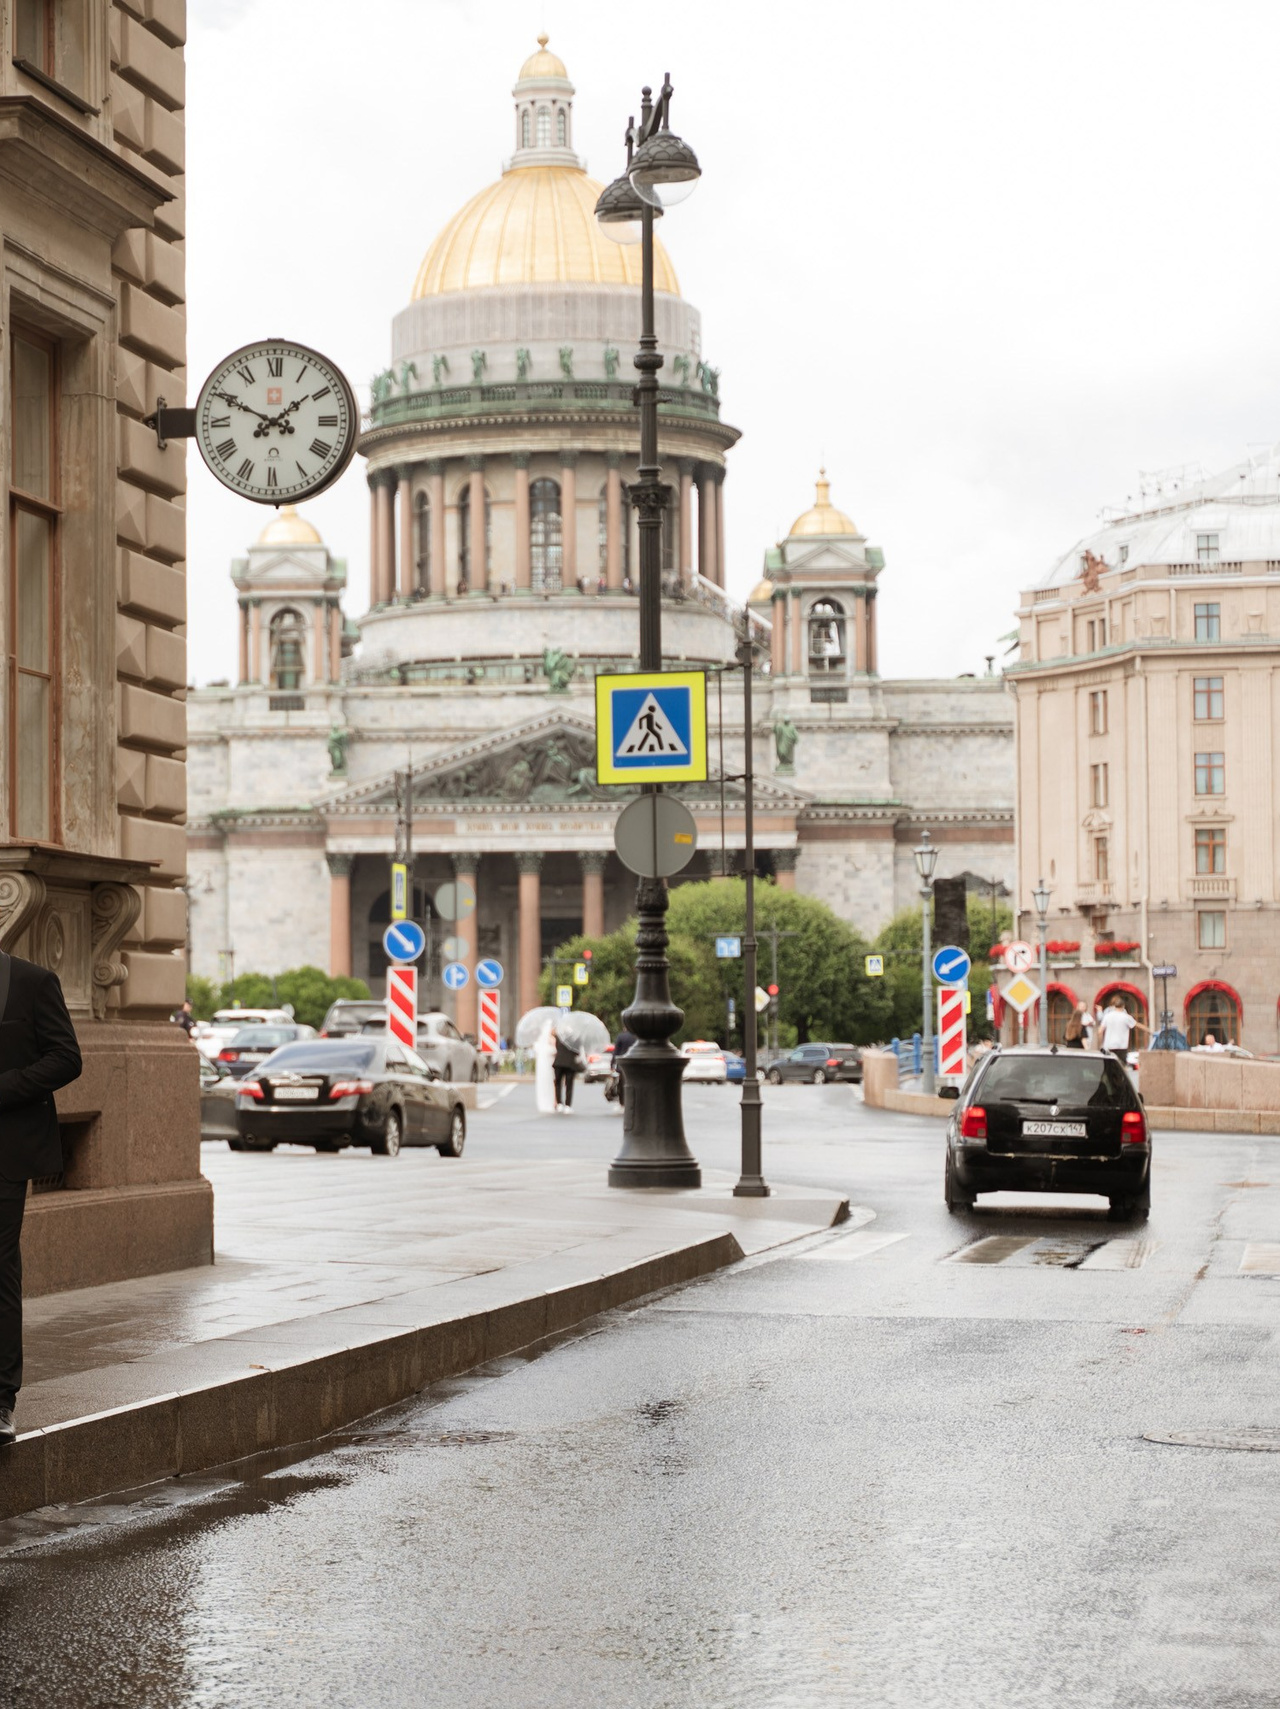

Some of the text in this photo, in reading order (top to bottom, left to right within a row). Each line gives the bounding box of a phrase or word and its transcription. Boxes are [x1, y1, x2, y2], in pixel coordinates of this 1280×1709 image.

[236, 365, 255, 387] XI
[266, 357, 283, 377] XII
[296, 365, 307, 383] I
[311, 386, 331, 401] II
[211, 415, 230, 428] IX
[318, 415, 338, 427] III
[215, 437, 238, 462] VIII
[236, 458, 255, 481] VII
[267, 466, 278, 487] VI
[295, 460, 308, 479] V
